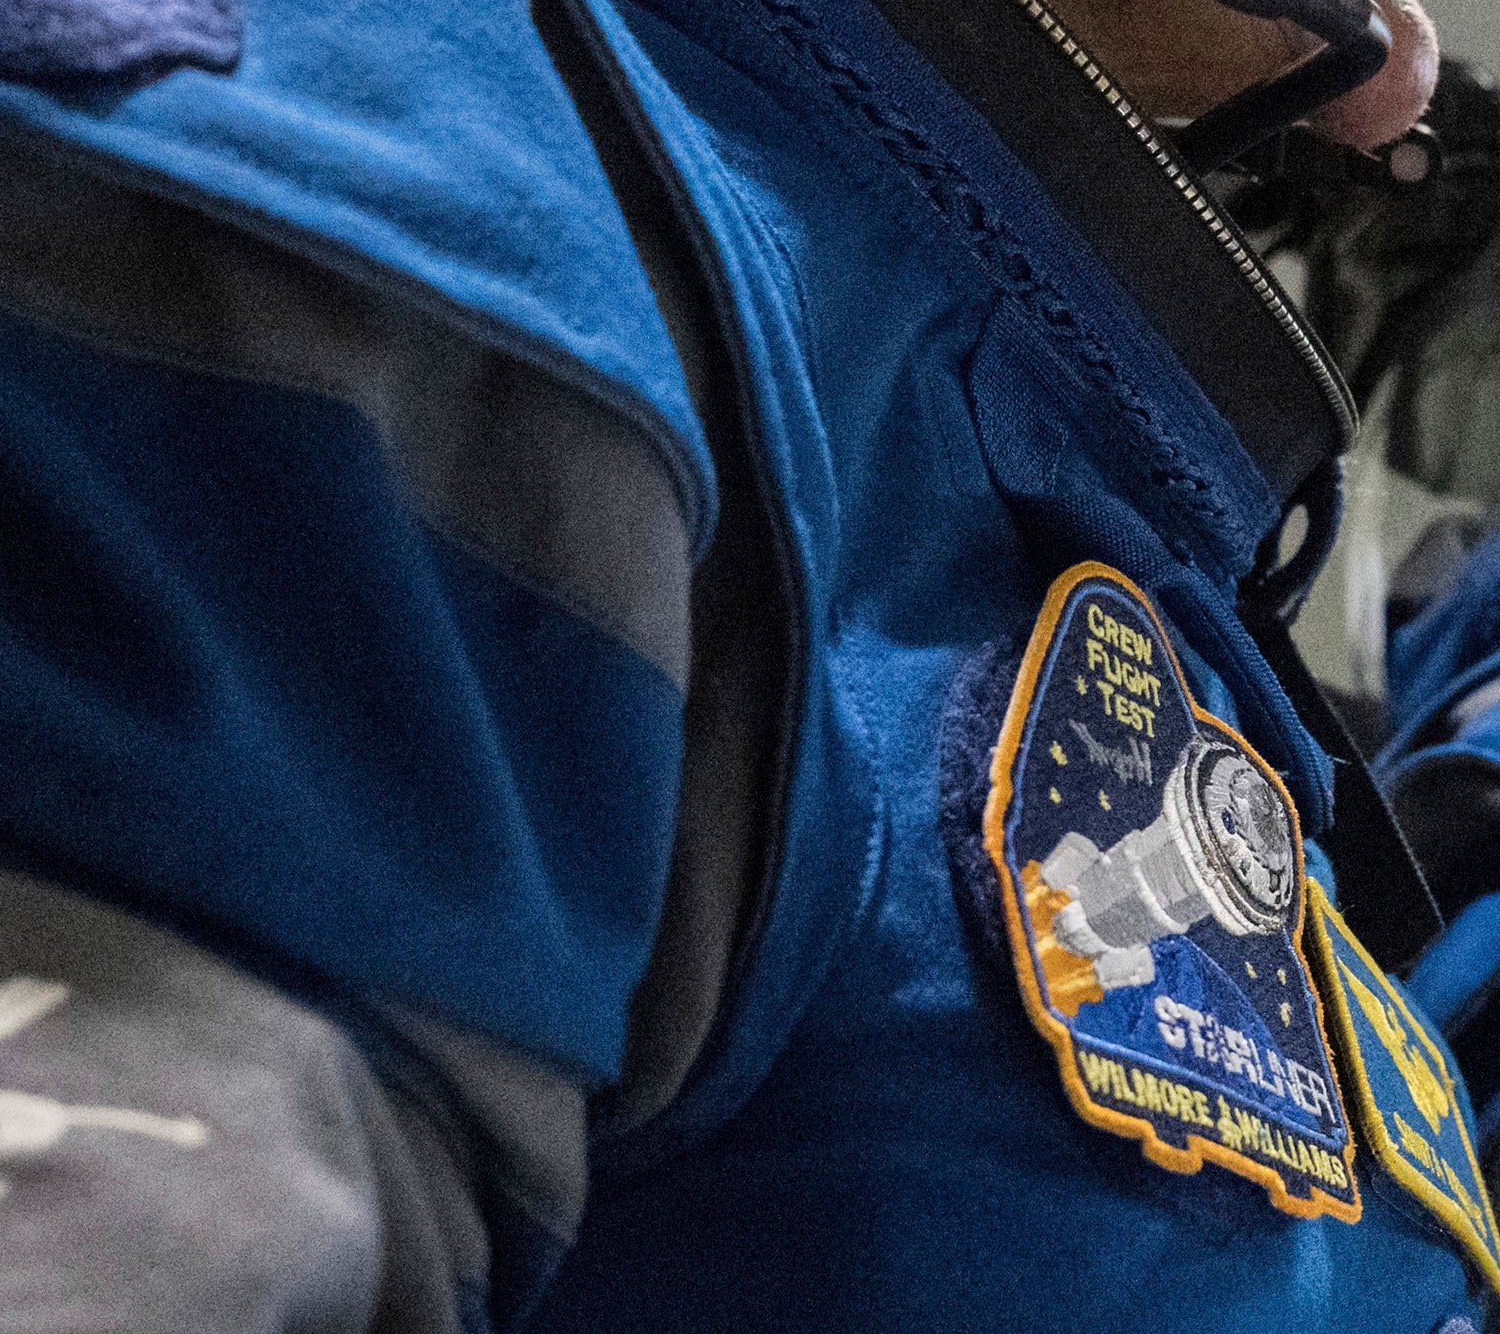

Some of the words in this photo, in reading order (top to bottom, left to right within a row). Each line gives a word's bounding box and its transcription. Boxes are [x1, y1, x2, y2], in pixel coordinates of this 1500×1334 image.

[1087, 603, 1152, 665] CREW
[1086, 638, 1161, 708] FLIGHT
[1097, 680, 1155, 738] TEST
[1079, 1050, 1214, 1128] WILMORE
[1234, 1107, 1348, 1189] WILLIAMS
